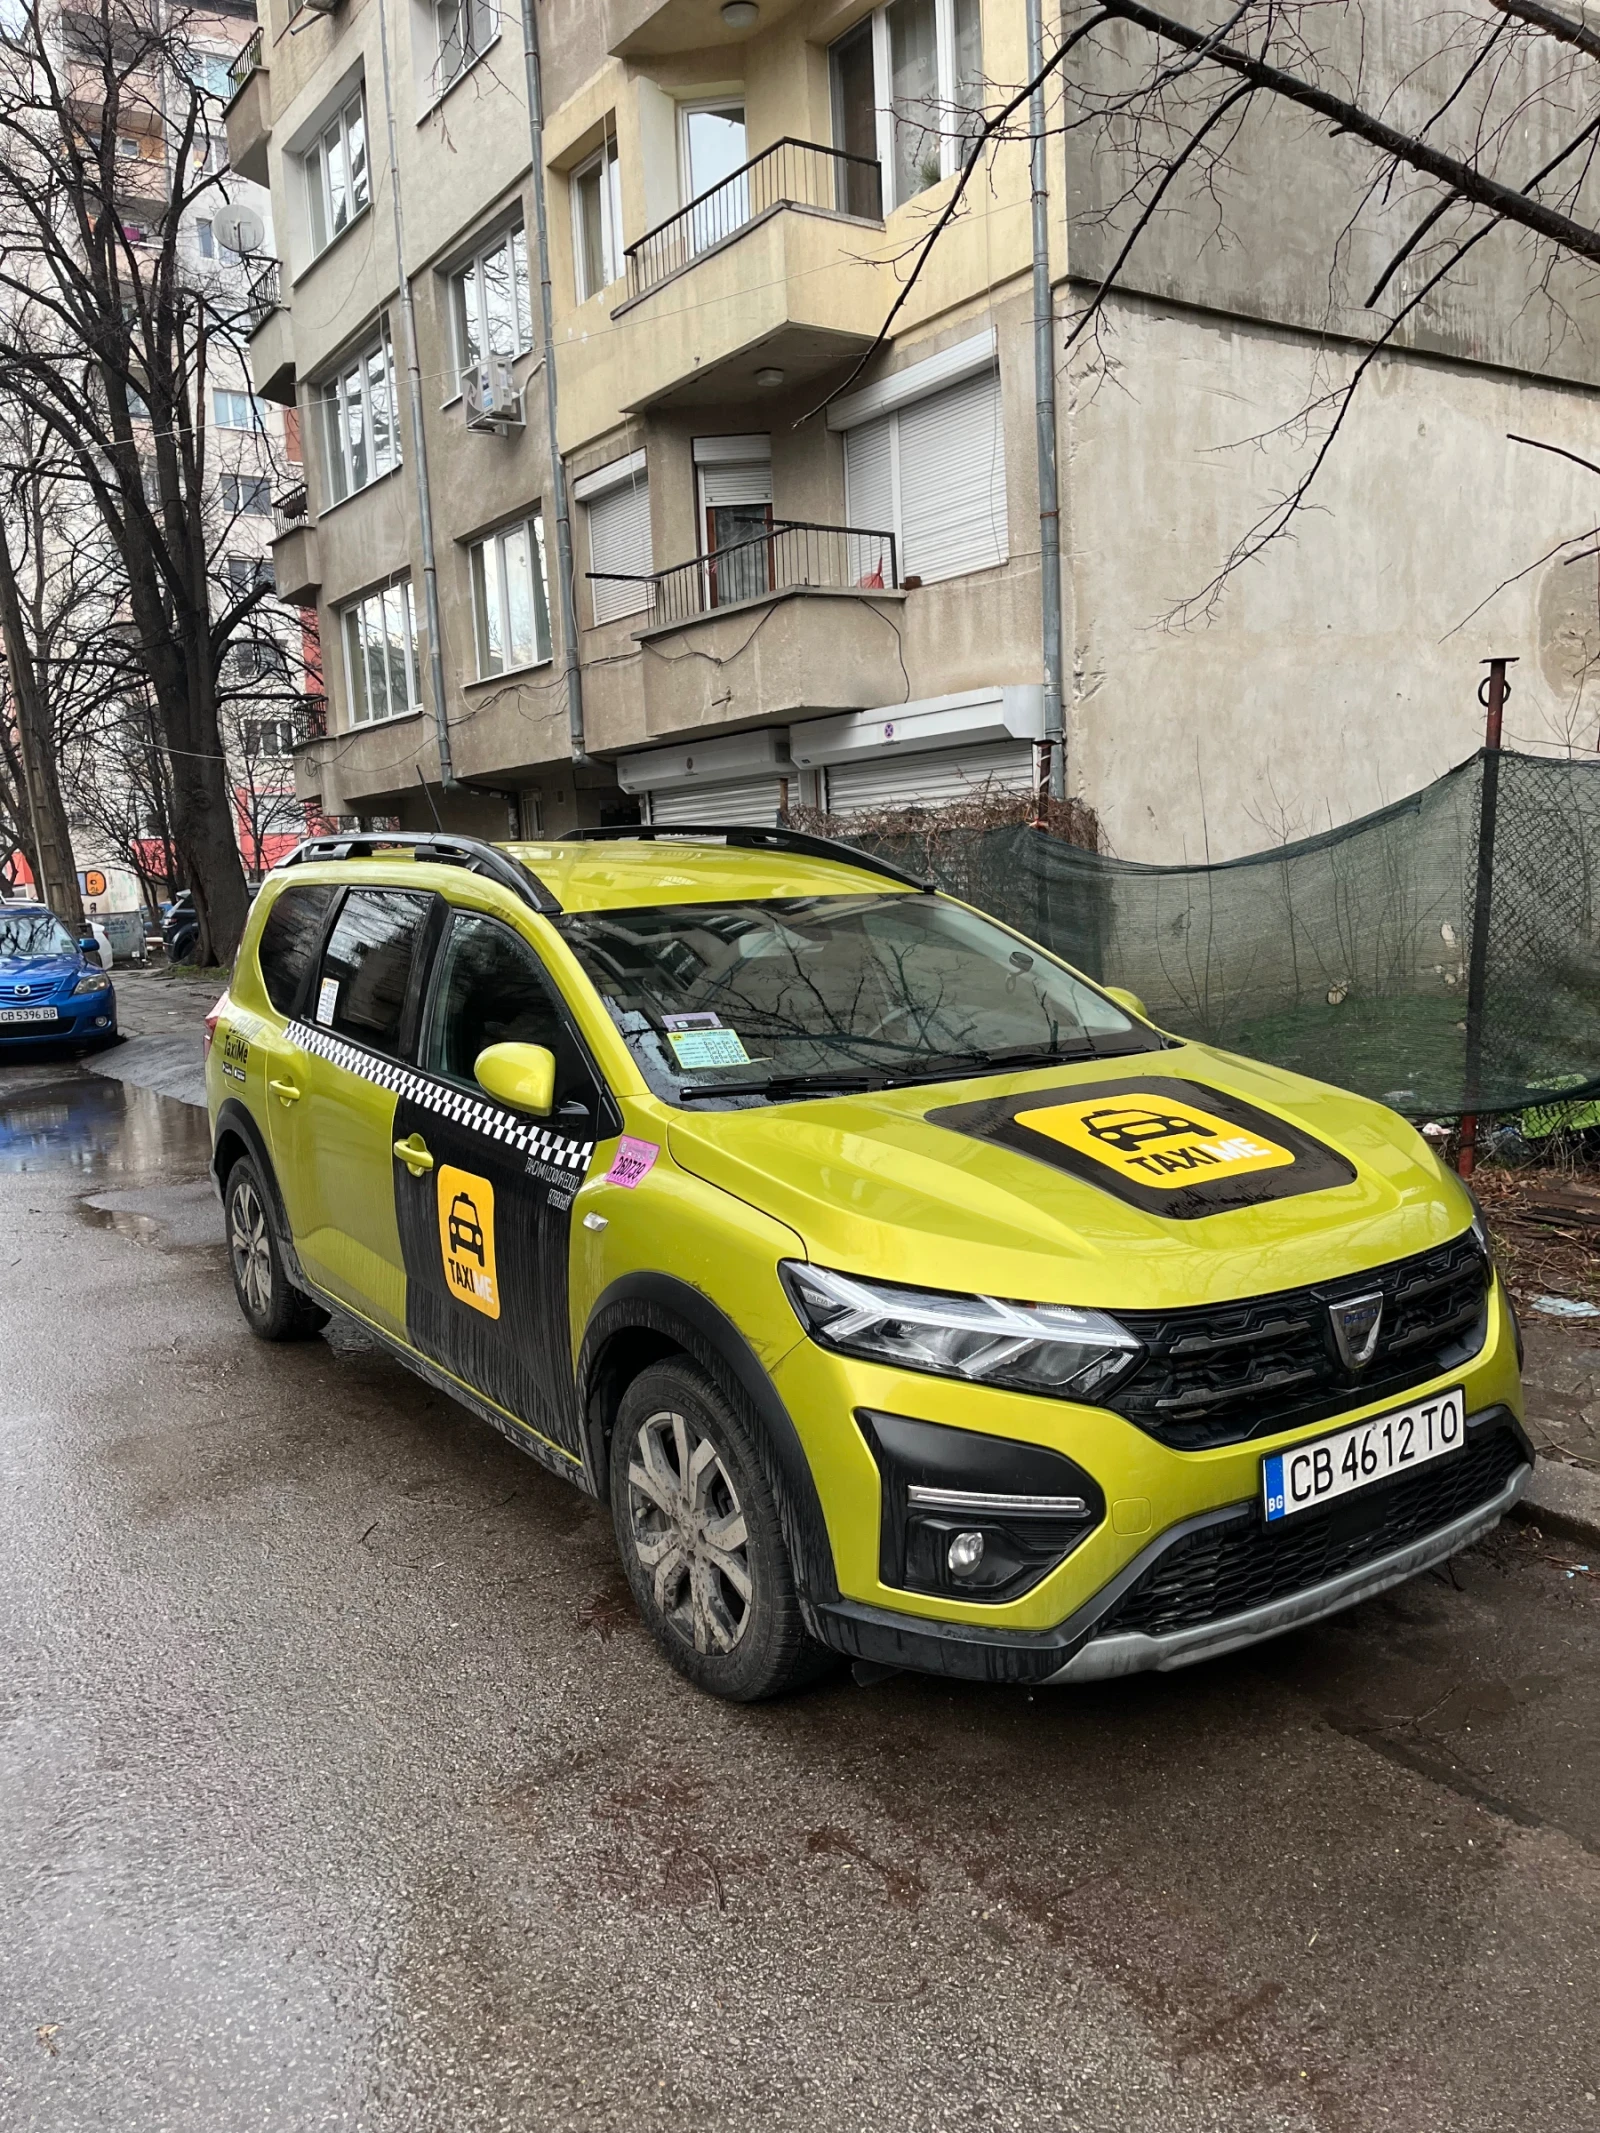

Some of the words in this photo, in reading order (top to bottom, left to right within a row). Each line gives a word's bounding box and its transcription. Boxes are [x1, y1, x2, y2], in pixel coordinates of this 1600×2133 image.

[1, 1011, 14, 1021] CB
[16, 1010, 41, 1020] 5396
[43, 1009, 56, 1019] BB
[224, 1035, 248, 1064] TaxiMe
[1124, 1137, 1272, 1176] TAXIME
[447, 1257, 495, 1304] TAXIME
[1344, 1307, 1378, 1325] DACIA
[1290, 1447, 1334, 1502] CB
[1341, 1416, 1415, 1482] 4612
[1420, 1400, 1458, 1451] TO
[1268, 1494, 1283, 1513] BG
